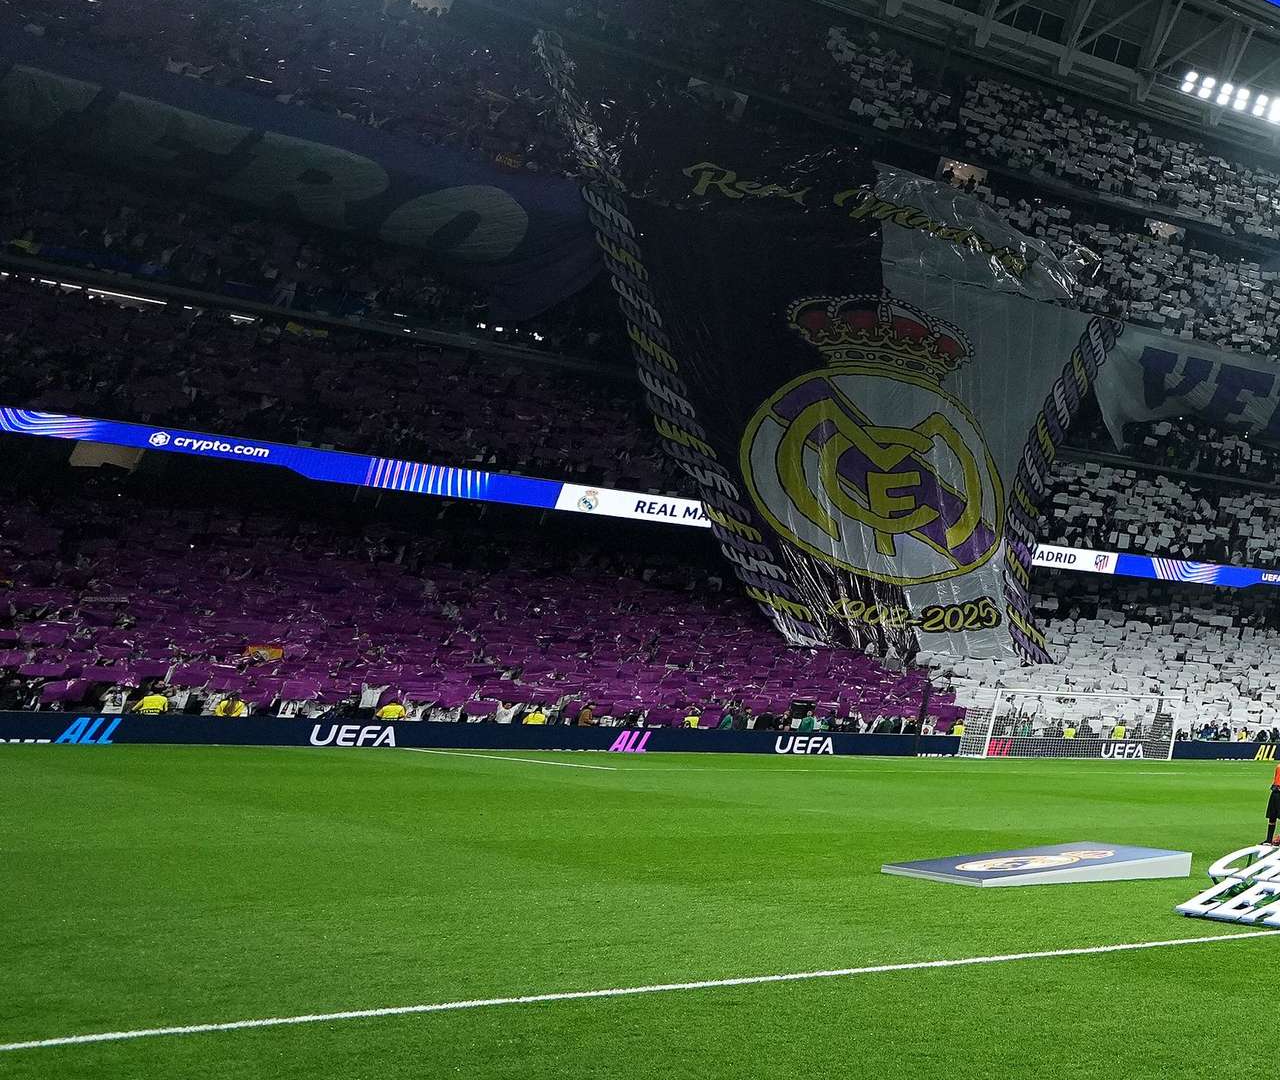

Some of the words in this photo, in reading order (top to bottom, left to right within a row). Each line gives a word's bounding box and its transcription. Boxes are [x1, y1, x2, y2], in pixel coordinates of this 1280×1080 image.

[173, 435, 270, 458] crypto.com
[634, 499, 679, 517] REAL
[54, 717, 122, 745] ALL
[310, 725, 397, 747] UEFA
[609, 731, 652, 753] ALL
[774, 736, 834, 755] UEFA
[1100, 743, 1144, 759] UEFA
[1254, 745, 1278, 760] ALL
